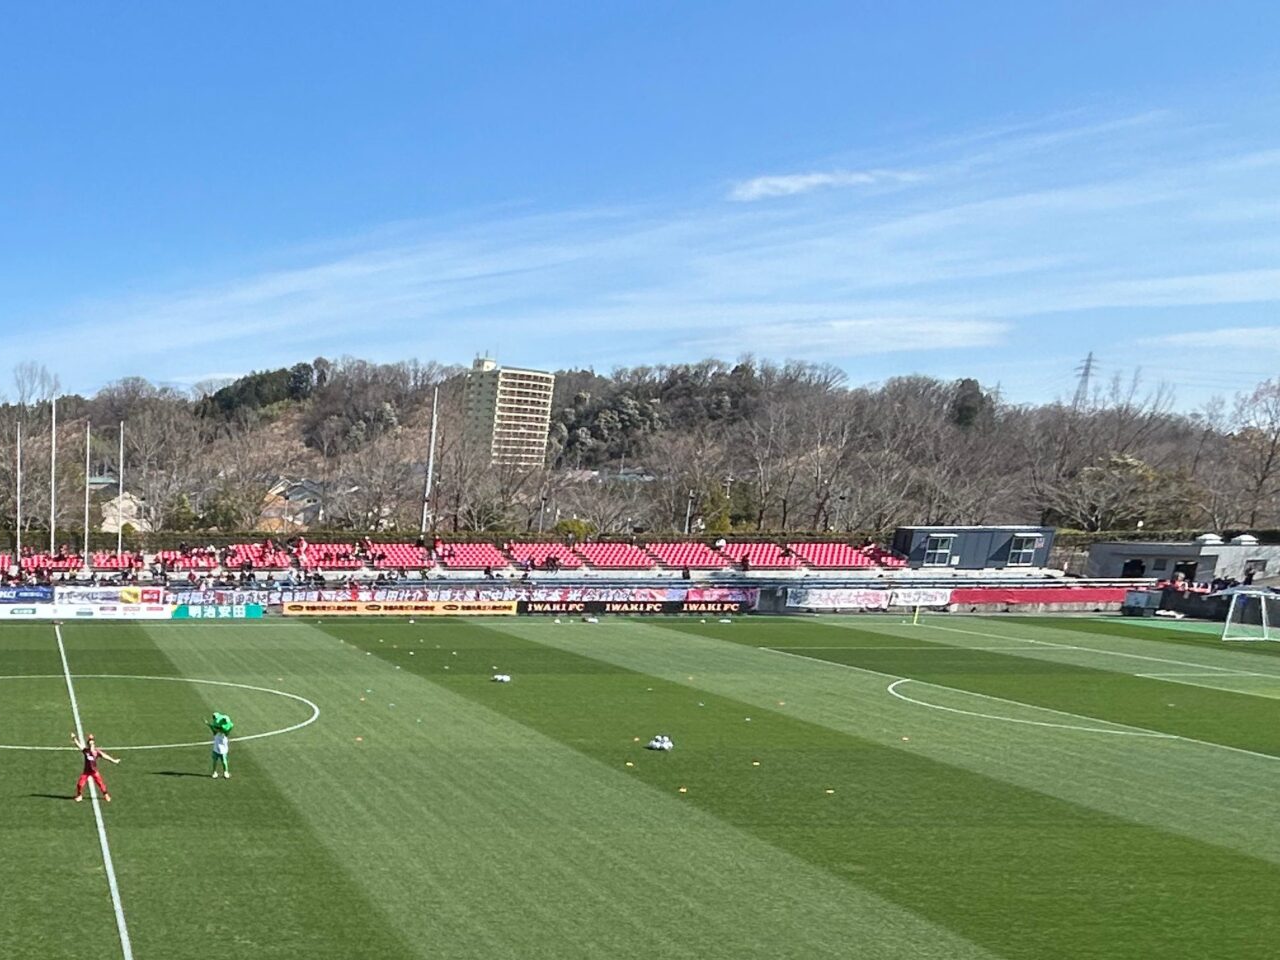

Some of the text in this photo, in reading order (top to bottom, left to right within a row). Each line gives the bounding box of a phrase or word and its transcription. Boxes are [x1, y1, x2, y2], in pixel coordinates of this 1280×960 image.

[188, 605, 246, 619] 明治安田
[527, 603, 585, 612] IWAKI FC
[605, 603, 663, 612] IWAKI FC
[682, 603, 740, 612] IWAKI FC
